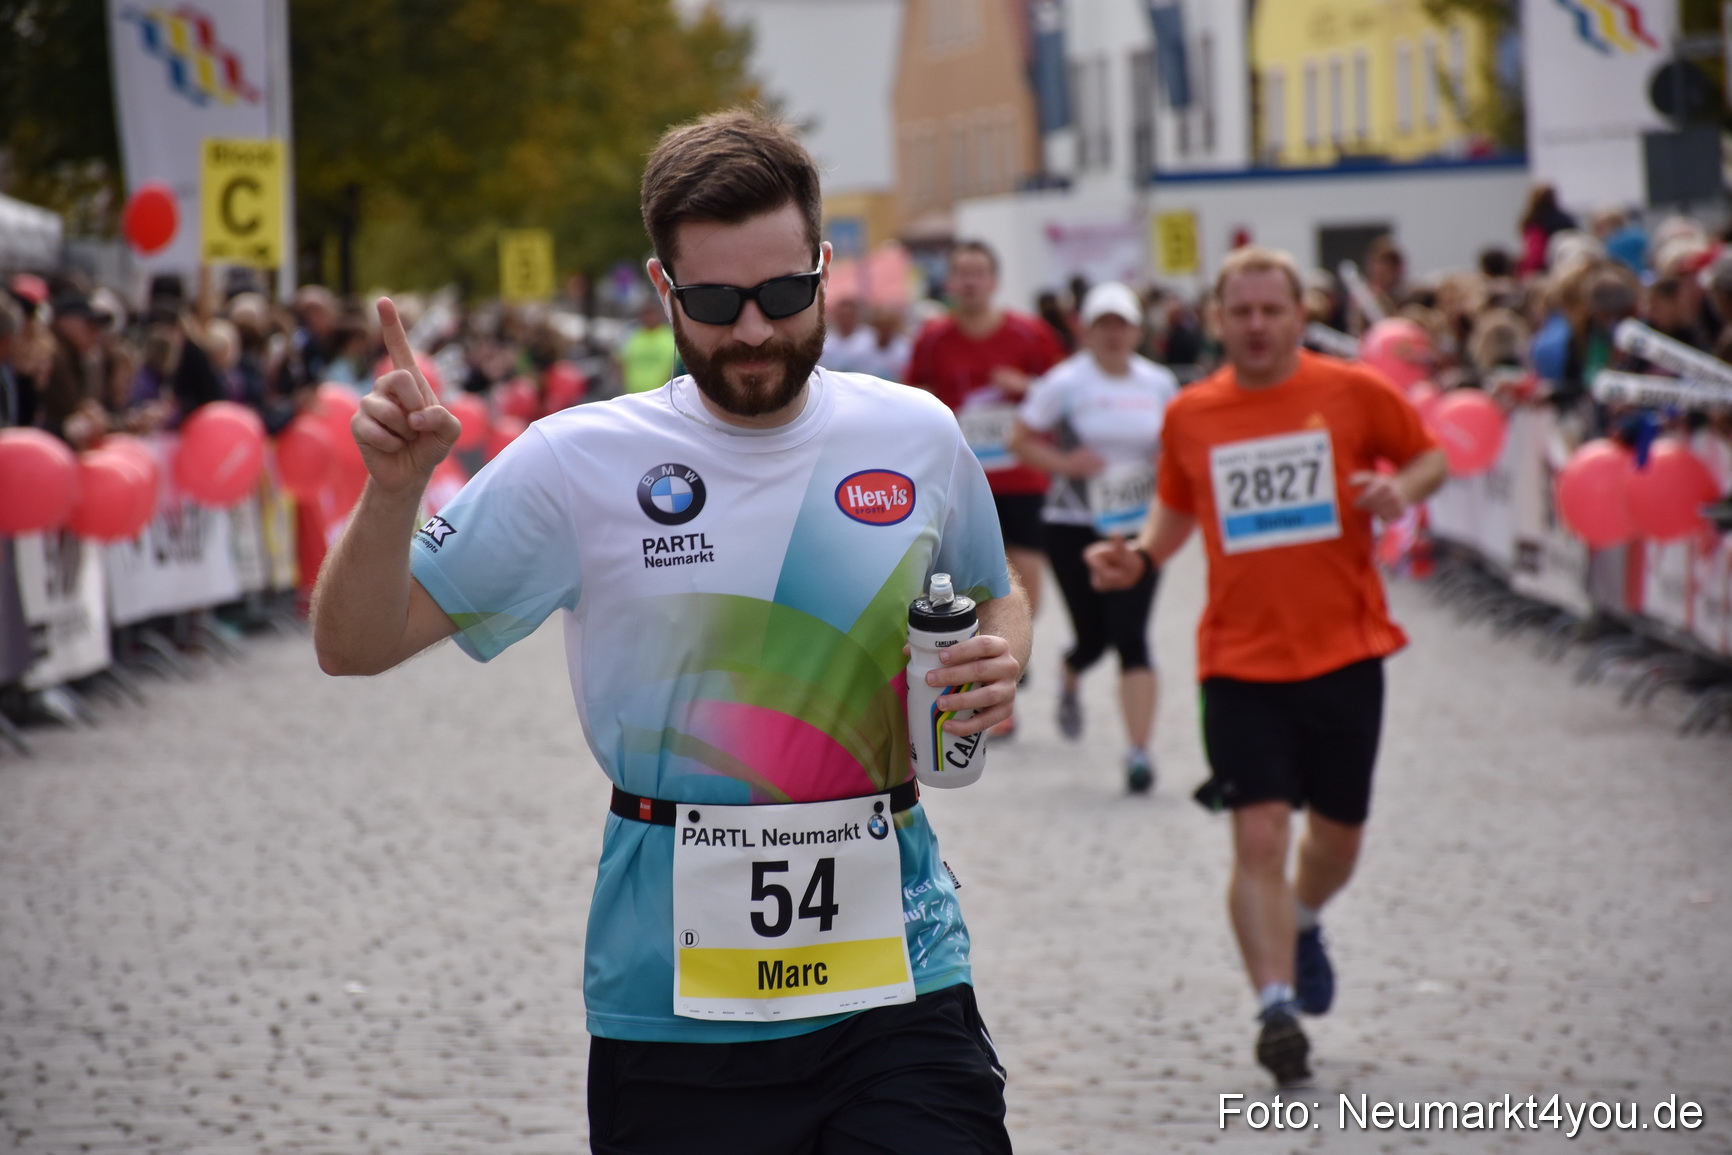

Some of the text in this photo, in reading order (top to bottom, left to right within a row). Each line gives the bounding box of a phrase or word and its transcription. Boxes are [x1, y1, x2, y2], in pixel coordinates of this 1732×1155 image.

[219, 176, 262, 237] C
[641, 465, 698, 487] BMW
[1226, 459, 1321, 509] 2827
[846, 484, 908, 511] Hervis
[642, 532, 714, 555] PARTL
[644, 551, 715, 569] Neumarkt
[681, 823, 861, 847] PARTL Neumarkt
[750, 857, 839, 938] 54
[757, 960, 828, 990] Marc
